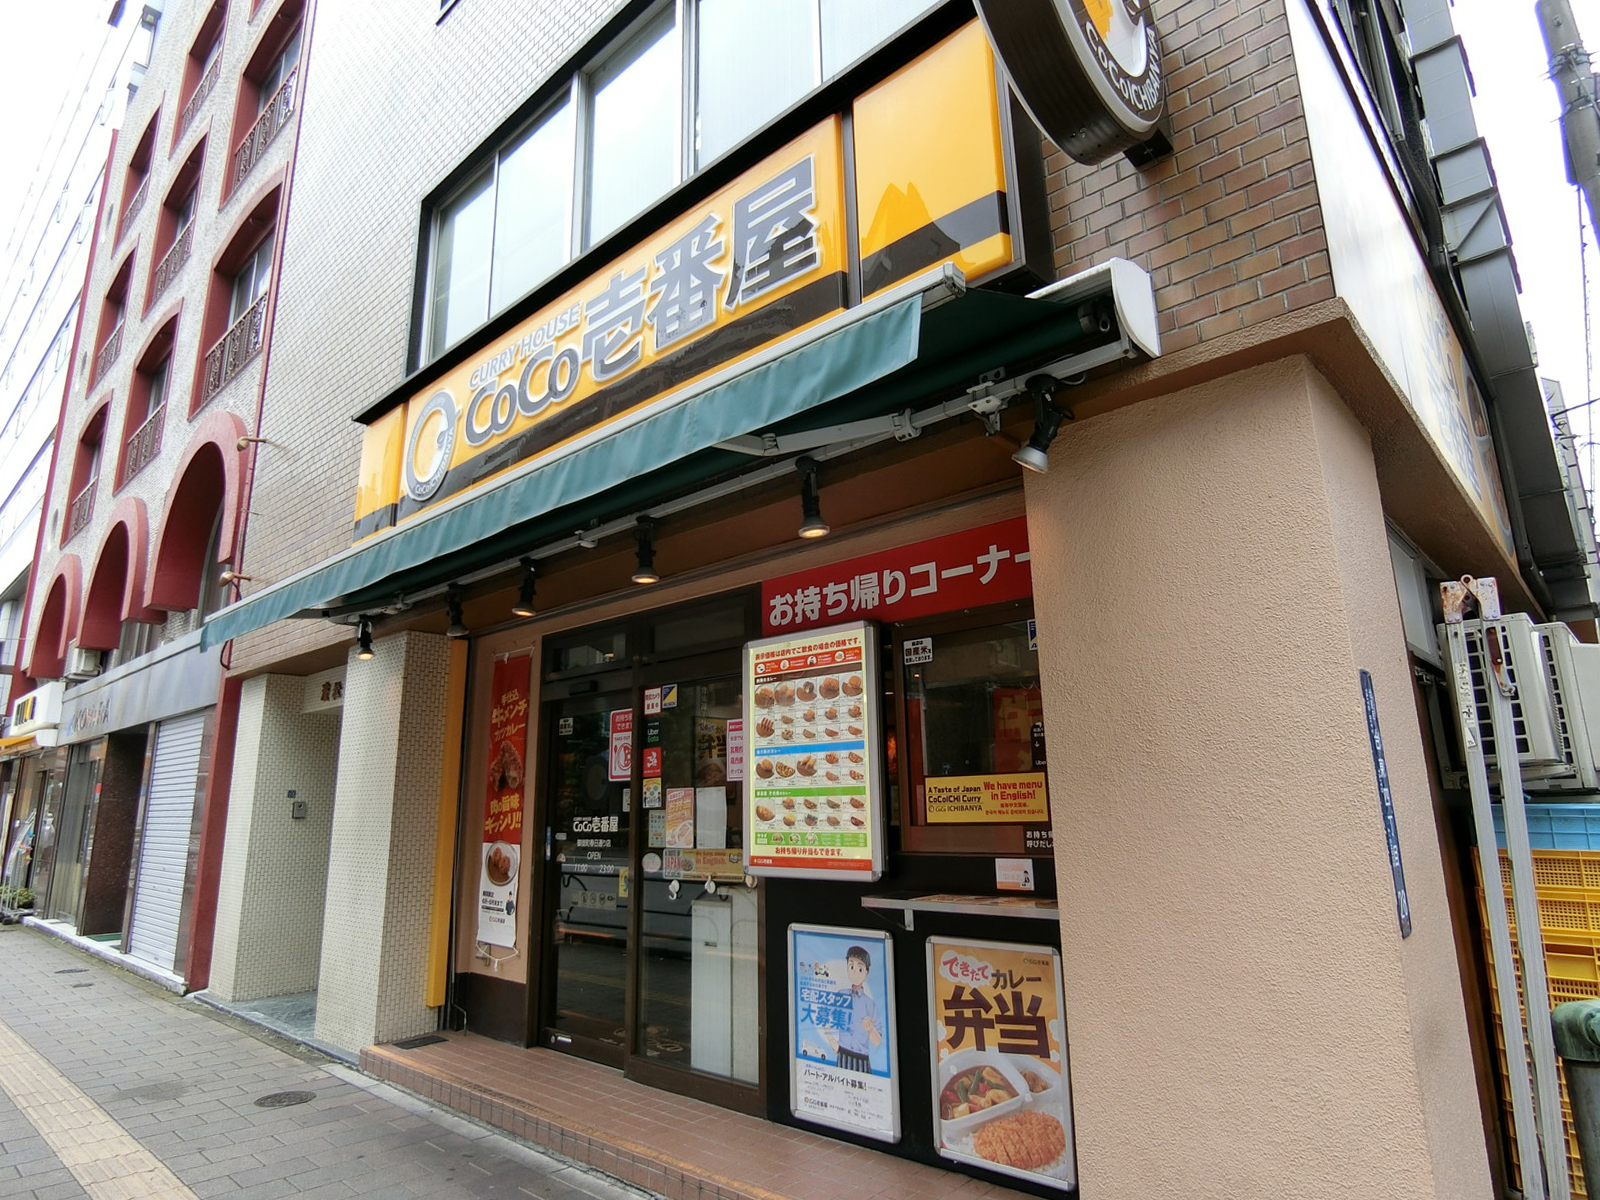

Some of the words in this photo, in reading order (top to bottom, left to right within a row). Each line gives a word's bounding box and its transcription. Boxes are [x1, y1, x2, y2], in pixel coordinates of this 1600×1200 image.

[1085, 21, 1161, 111] CoCoICHIBANYA
[464, 153, 822, 447] CoCo壱番屋
[469, 340, 518, 390] CURRY
[519, 300, 583, 358] HOUSE
[492, 698, 528, 728] 牛メンチ
[494, 723, 526, 742] カツカレー
[647, 728, 660, 736] Uber
[953, 785, 960, 793] of
[962, 785, 981, 794] Japan
[983, 781, 995, 791] We
[997, 781, 1017, 790] have
[1019, 780, 1043, 789] menu
[928, 794, 961, 803] CoCoICHI
[962, 794, 981, 803] Curry
[991, 791, 999, 800] in
[1000, 789, 1036, 801] English!
[490, 793, 520, 815] 肉の旨味
[947, 804, 983, 812] ICHIBANYA
[573, 815, 619, 832] CoCo壱番屋
[775, 846, 843, 857] お持ち帰り弁当もできます。
[1026, 840, 1054, 848] 呼びだし
[586, 851, 602, 860] OPEN
[942, 956, 989, 982] できたて
[991, 968, 1042, 990] カレー
[801, 988, 852, 1007] 宅配スタッフ
[943, 985, 1051, 1059] 弁当
